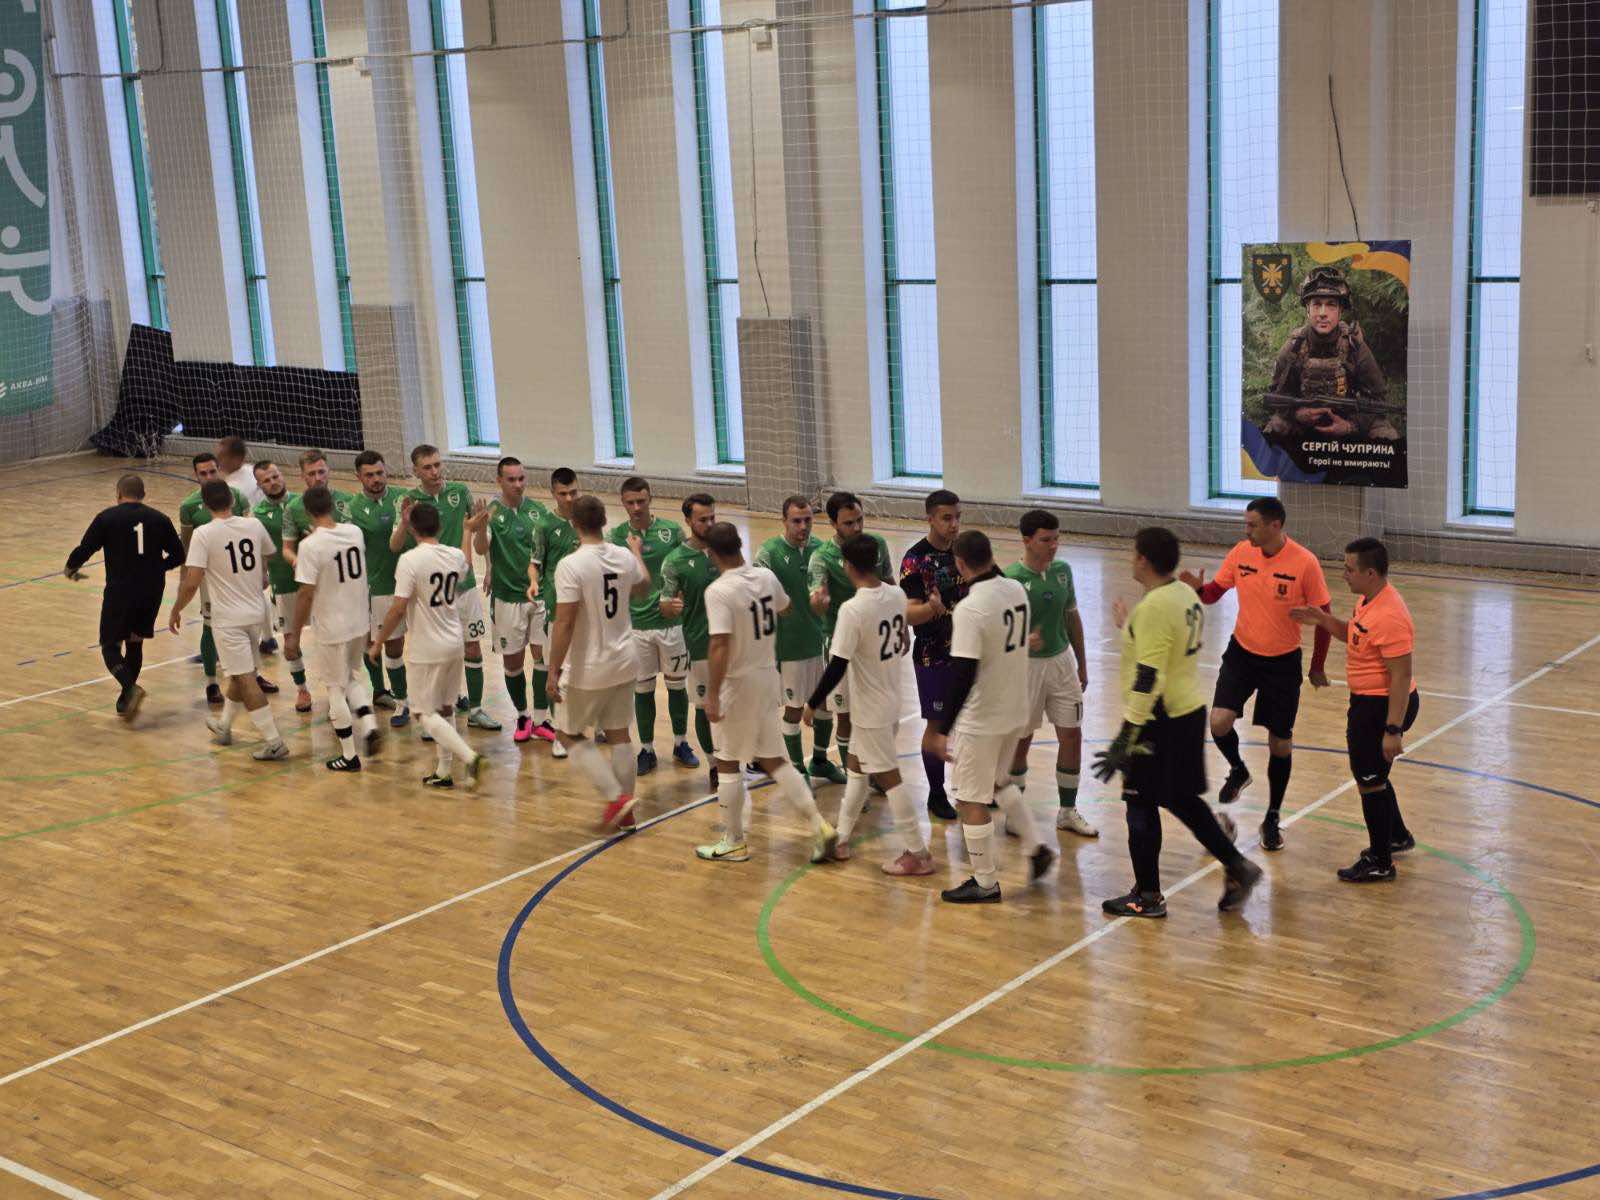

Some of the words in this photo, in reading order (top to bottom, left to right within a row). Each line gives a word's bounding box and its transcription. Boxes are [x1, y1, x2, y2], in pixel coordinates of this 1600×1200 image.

[1301, 440, 1340, 452] СЕРГІЙ
[1341, 443, 1395, 455] ЧУПРИНА
[1308, 457, 1331, 468] Герої
[1332, 458, 1342, 466] не
[1344, 460, 1390, 469] вмирають!
[133, 522, 145, 555] 1
[224, 538, 256, 574] 18
[334, 546, 362, 583] 10
[429, 571, 459, 607] 20
[603, 573, 618, 620] 5
[467, 619, 486, 638] 33
[749, 595, 775, 640] 15
[1003, 603, 1027, 653] 27
[878, 614, 904, 662] 23
